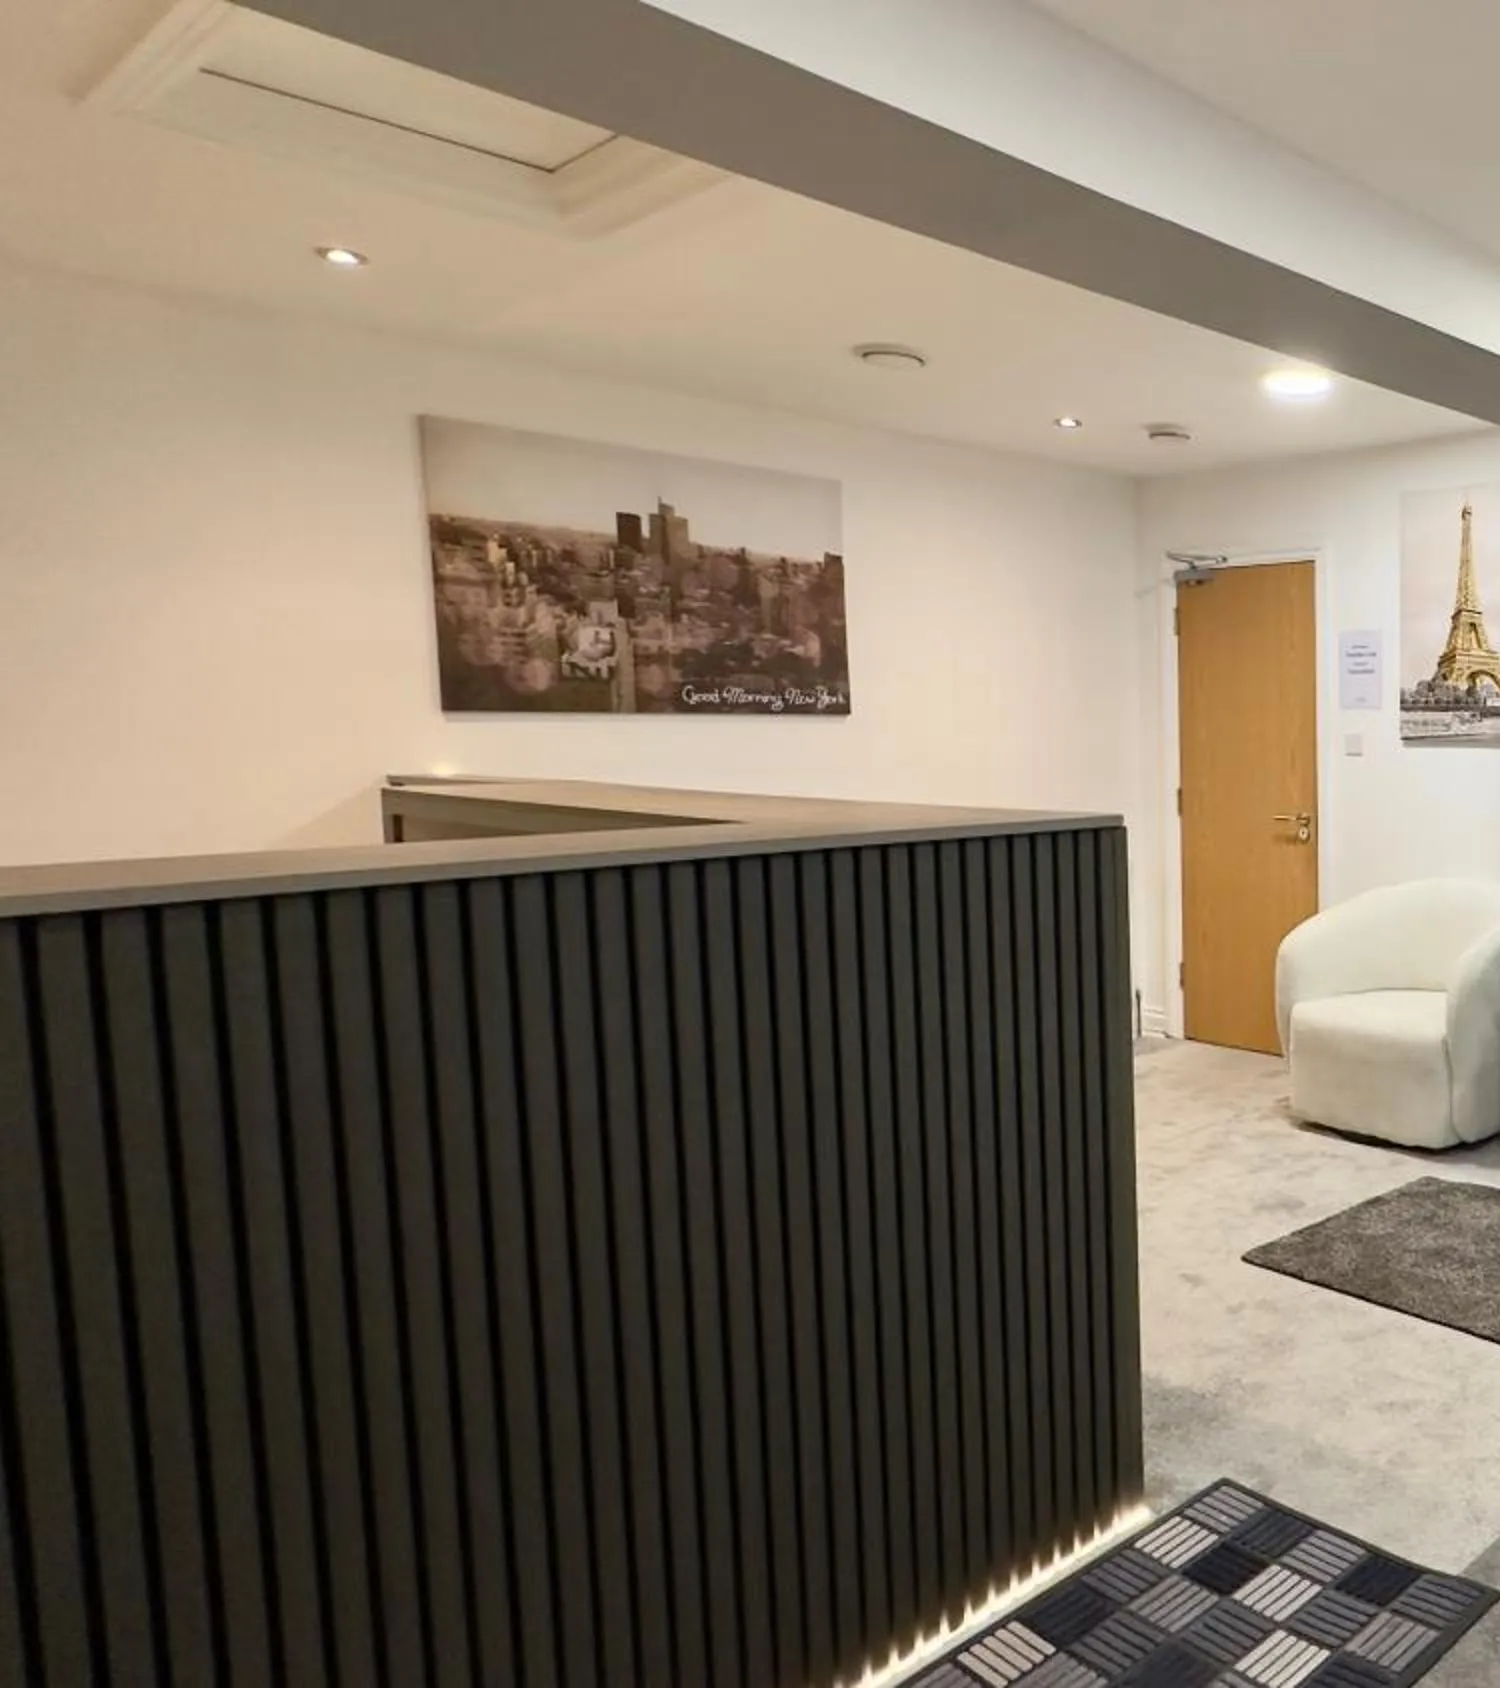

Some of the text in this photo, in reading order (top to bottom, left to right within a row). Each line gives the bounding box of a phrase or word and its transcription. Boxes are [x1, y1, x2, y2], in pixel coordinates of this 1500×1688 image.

[681, 685, 847, 711] Good Morning New York
